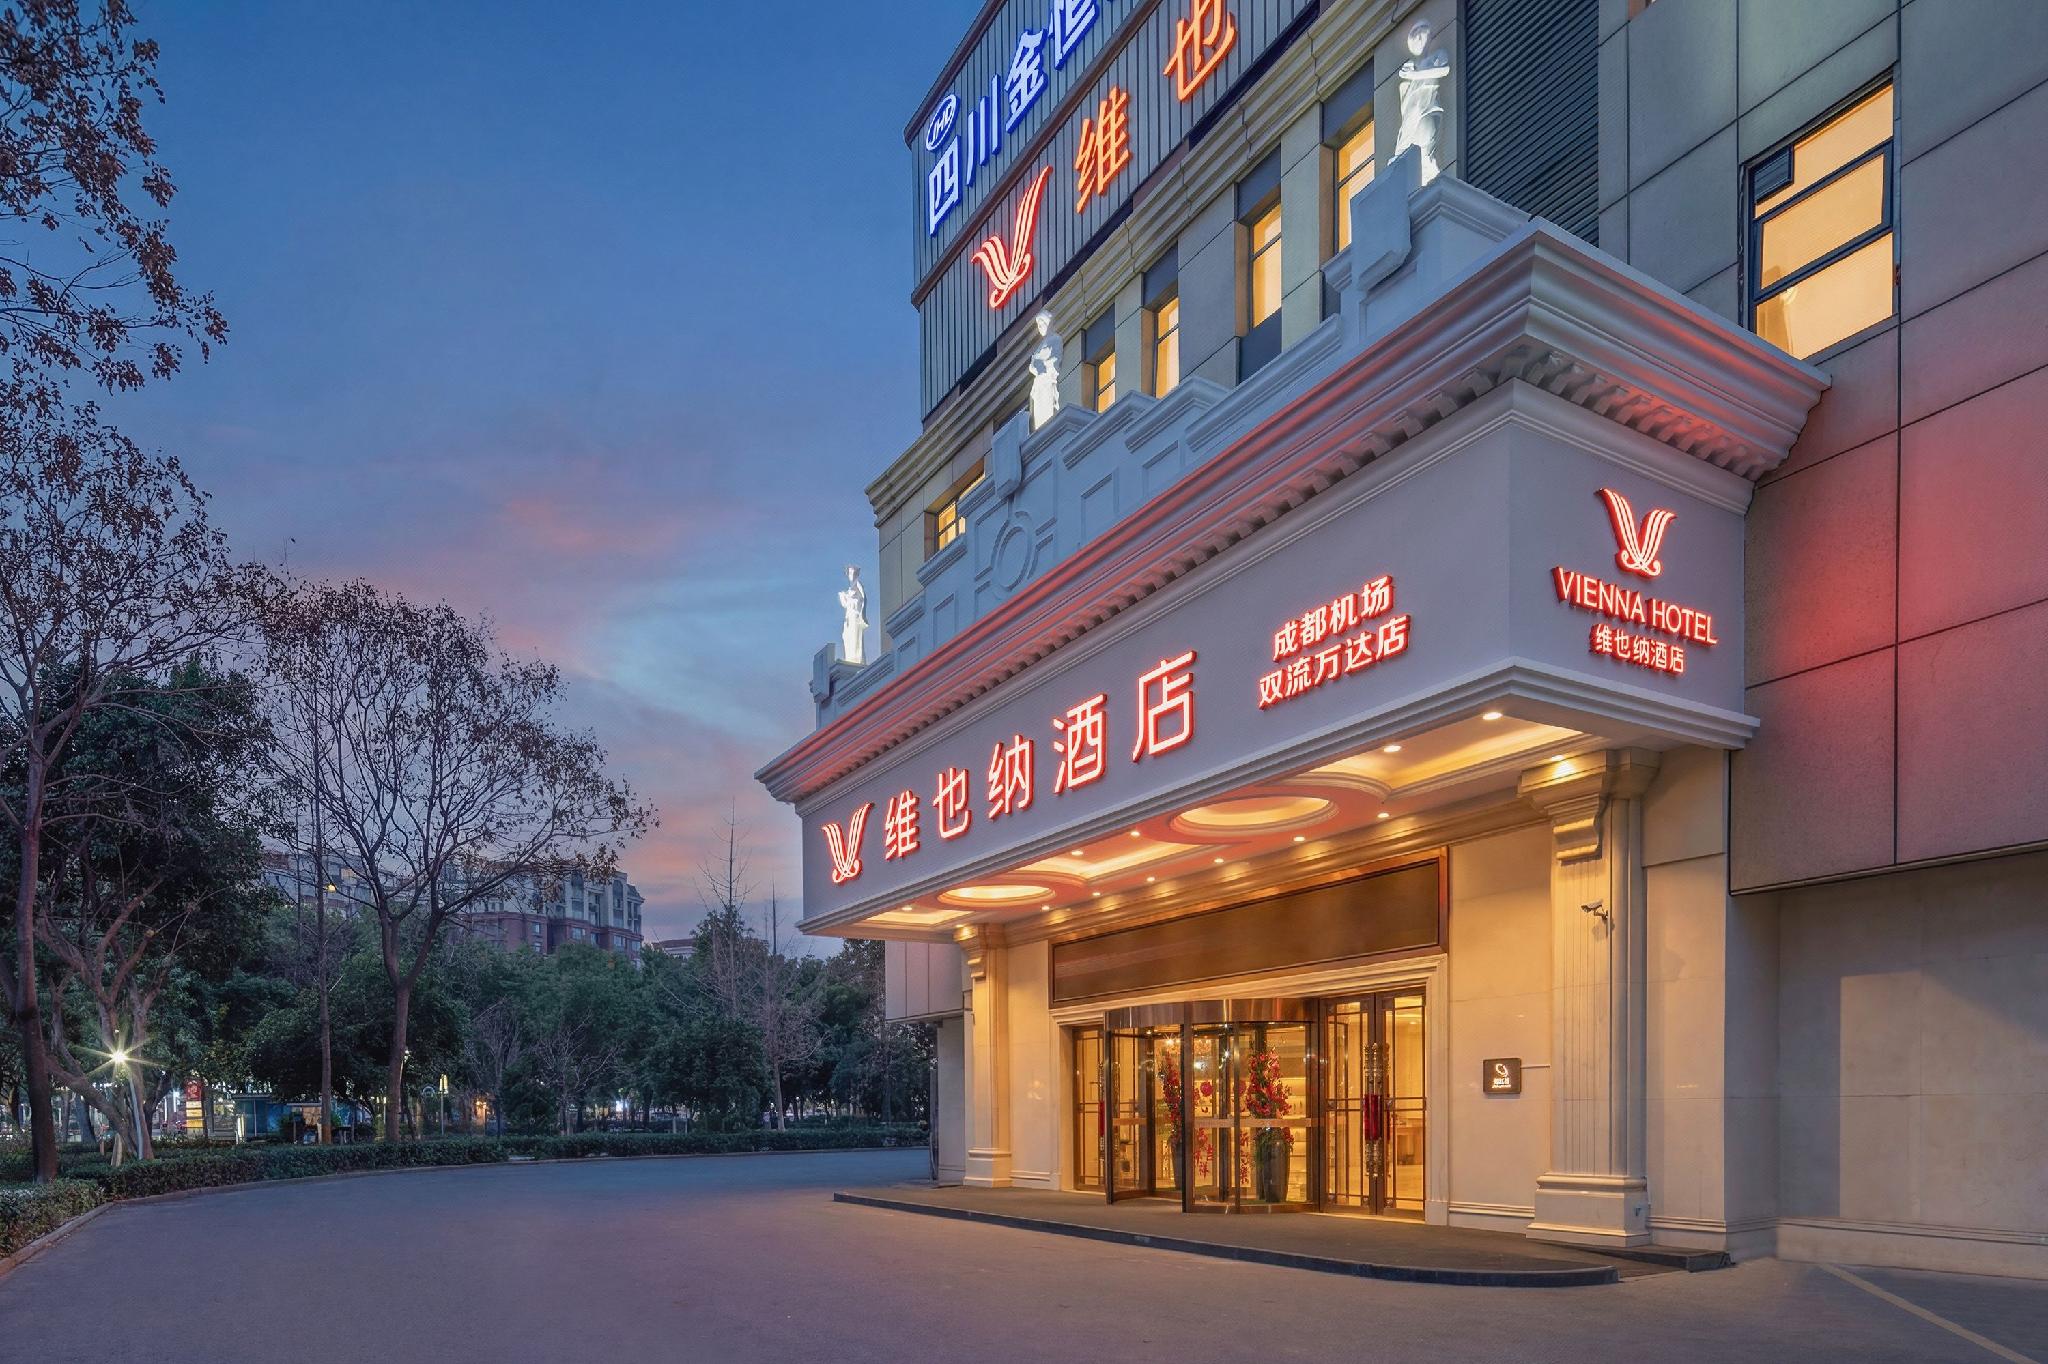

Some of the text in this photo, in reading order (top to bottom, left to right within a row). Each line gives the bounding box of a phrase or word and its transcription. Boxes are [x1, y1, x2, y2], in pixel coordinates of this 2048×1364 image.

[1272, 575, 1393, 663] 成都机场
[1552, 566, 1718, 645] VIENNA HOTEL
[1591, 623, 1685, 675] 维也纳酒店
[1258, 614, 1412, 710] 双流万达店
[884, 650, 1198, 862] 维也纳酒店
